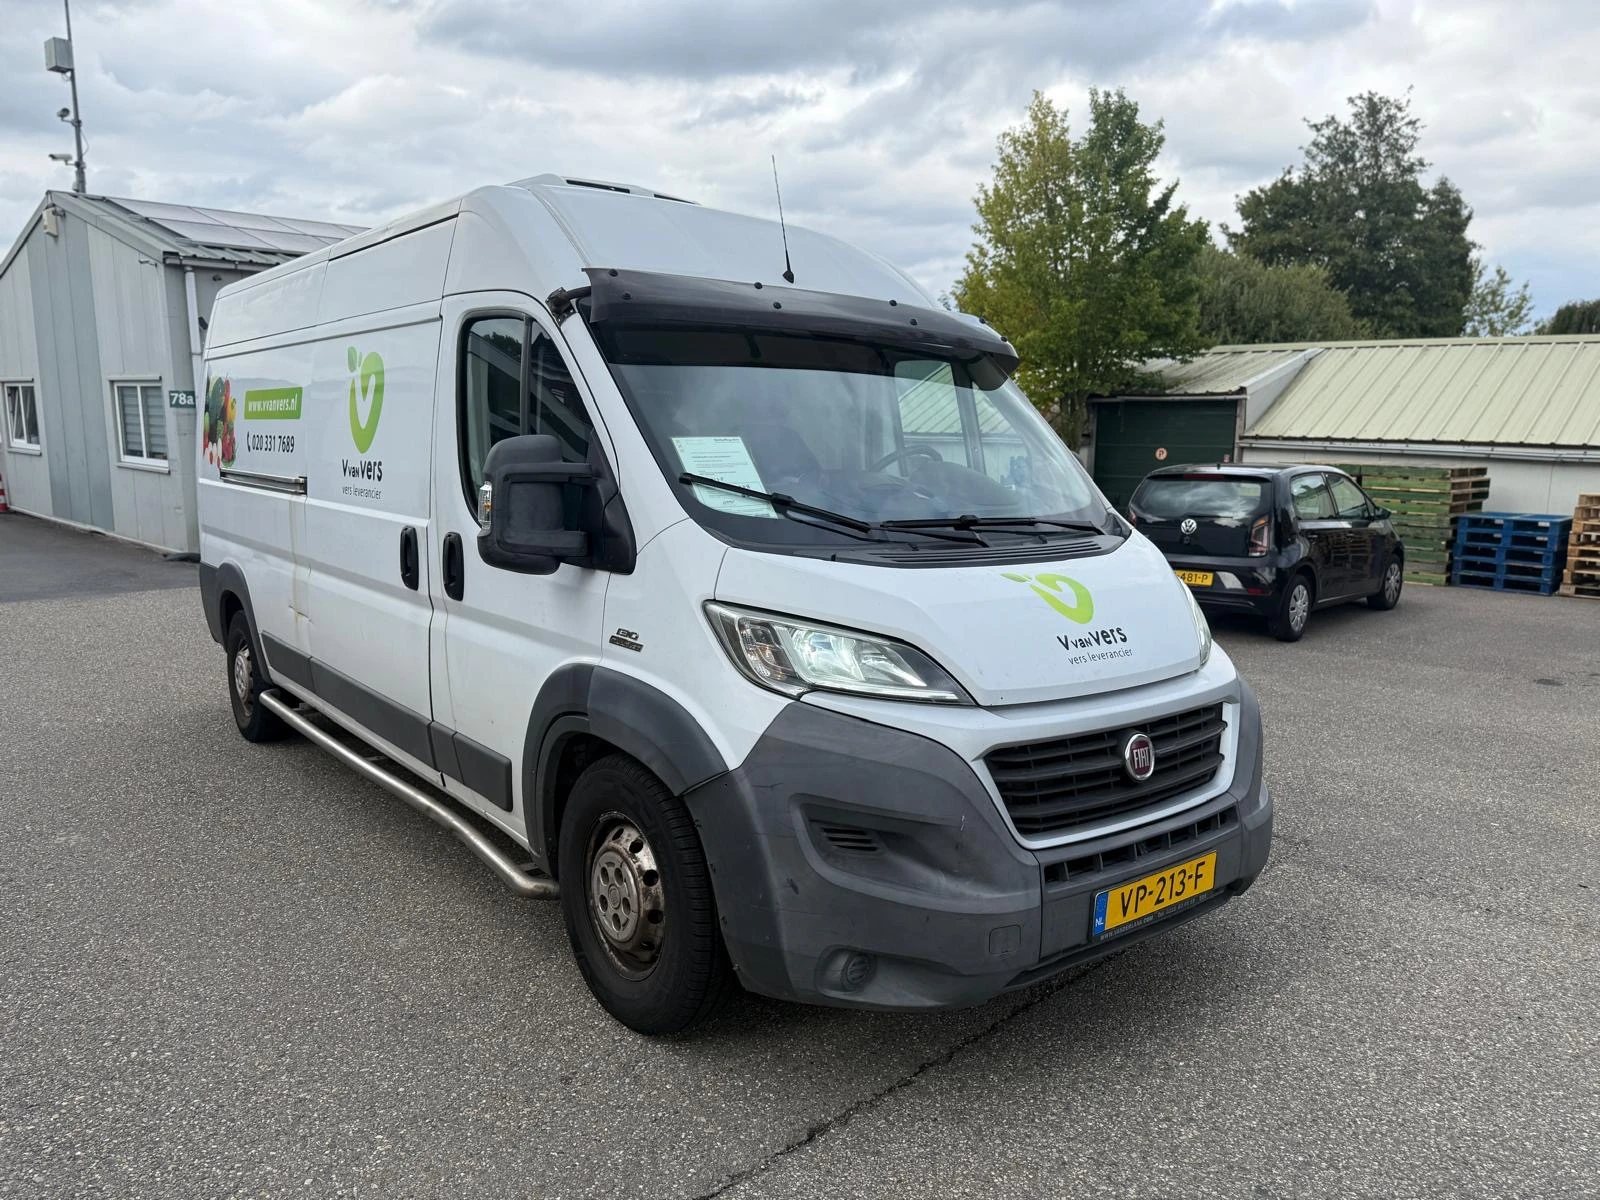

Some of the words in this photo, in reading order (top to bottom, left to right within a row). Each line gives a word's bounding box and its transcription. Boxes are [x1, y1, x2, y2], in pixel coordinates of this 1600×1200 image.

[170, 392, 195, 405] 78a
[248, 393, 298, 412] www.vvanvers.nl
[252, 434, 264, 451] 020
[264, 435, 276, 452] 331
[278, 435, 295, 453] 7689
[352, 484, 382, 500] leverancier
[1067, 655, 1088, 665] vers
[1087, 648, 1133, 662] leverancier
[1132, 746, 1150, 769] FIAT
[1120, 861, 1206, 919] VP-213-F
[1095, 917, 1104, 927] NL
